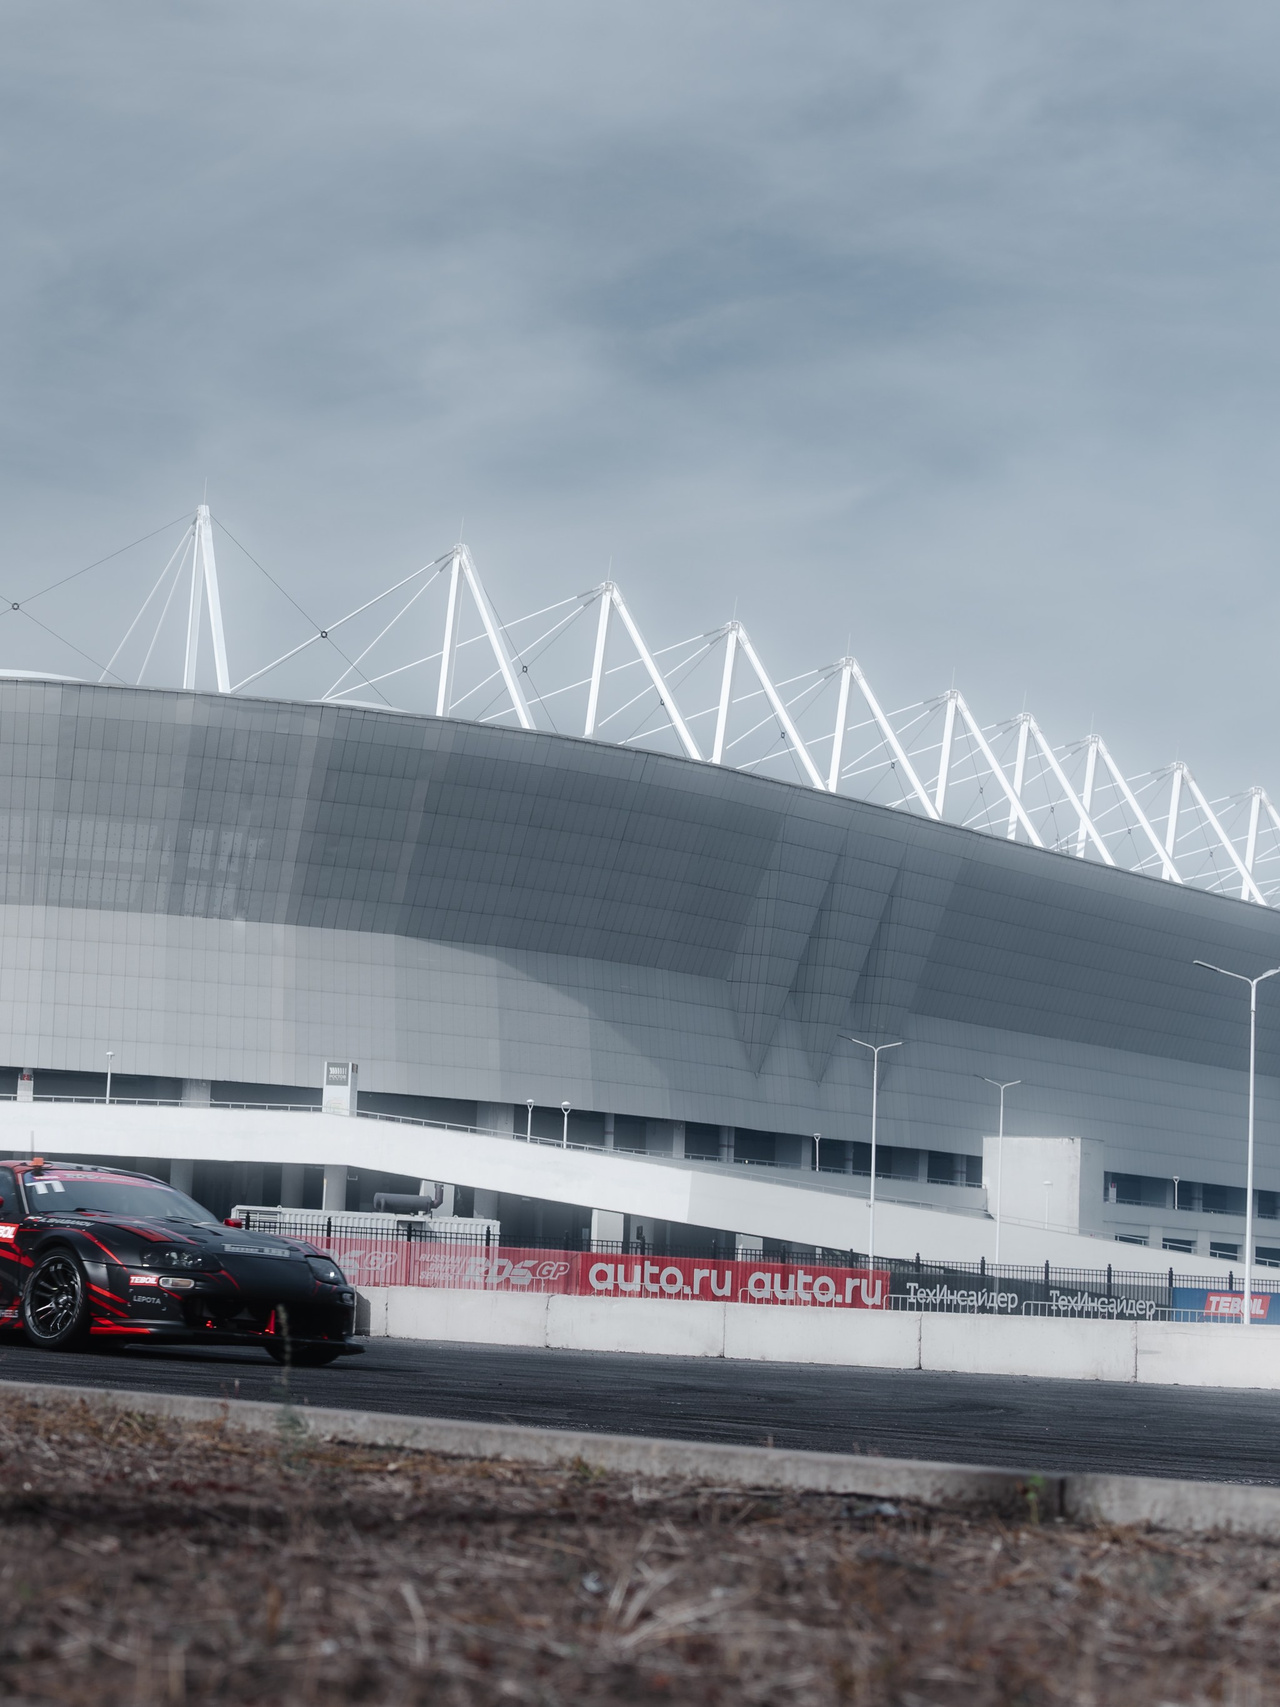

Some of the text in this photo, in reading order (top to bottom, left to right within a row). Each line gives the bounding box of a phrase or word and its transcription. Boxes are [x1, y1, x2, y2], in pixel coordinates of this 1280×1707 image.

[130, 1276, 158, 1284] TEBOIL
[463, 1257, 570, 1285] RDS GP
[589, 1261, 732, 1297] auto.ru
[133, 1295, 161, 1305] LEPOTA
[747, 1270, 882, 1305] auto.ru
[906, 1282, 1018, 1312] ТехИнсайдер
[1049, 1290, 1156, 1319] ТехИнсайдер
